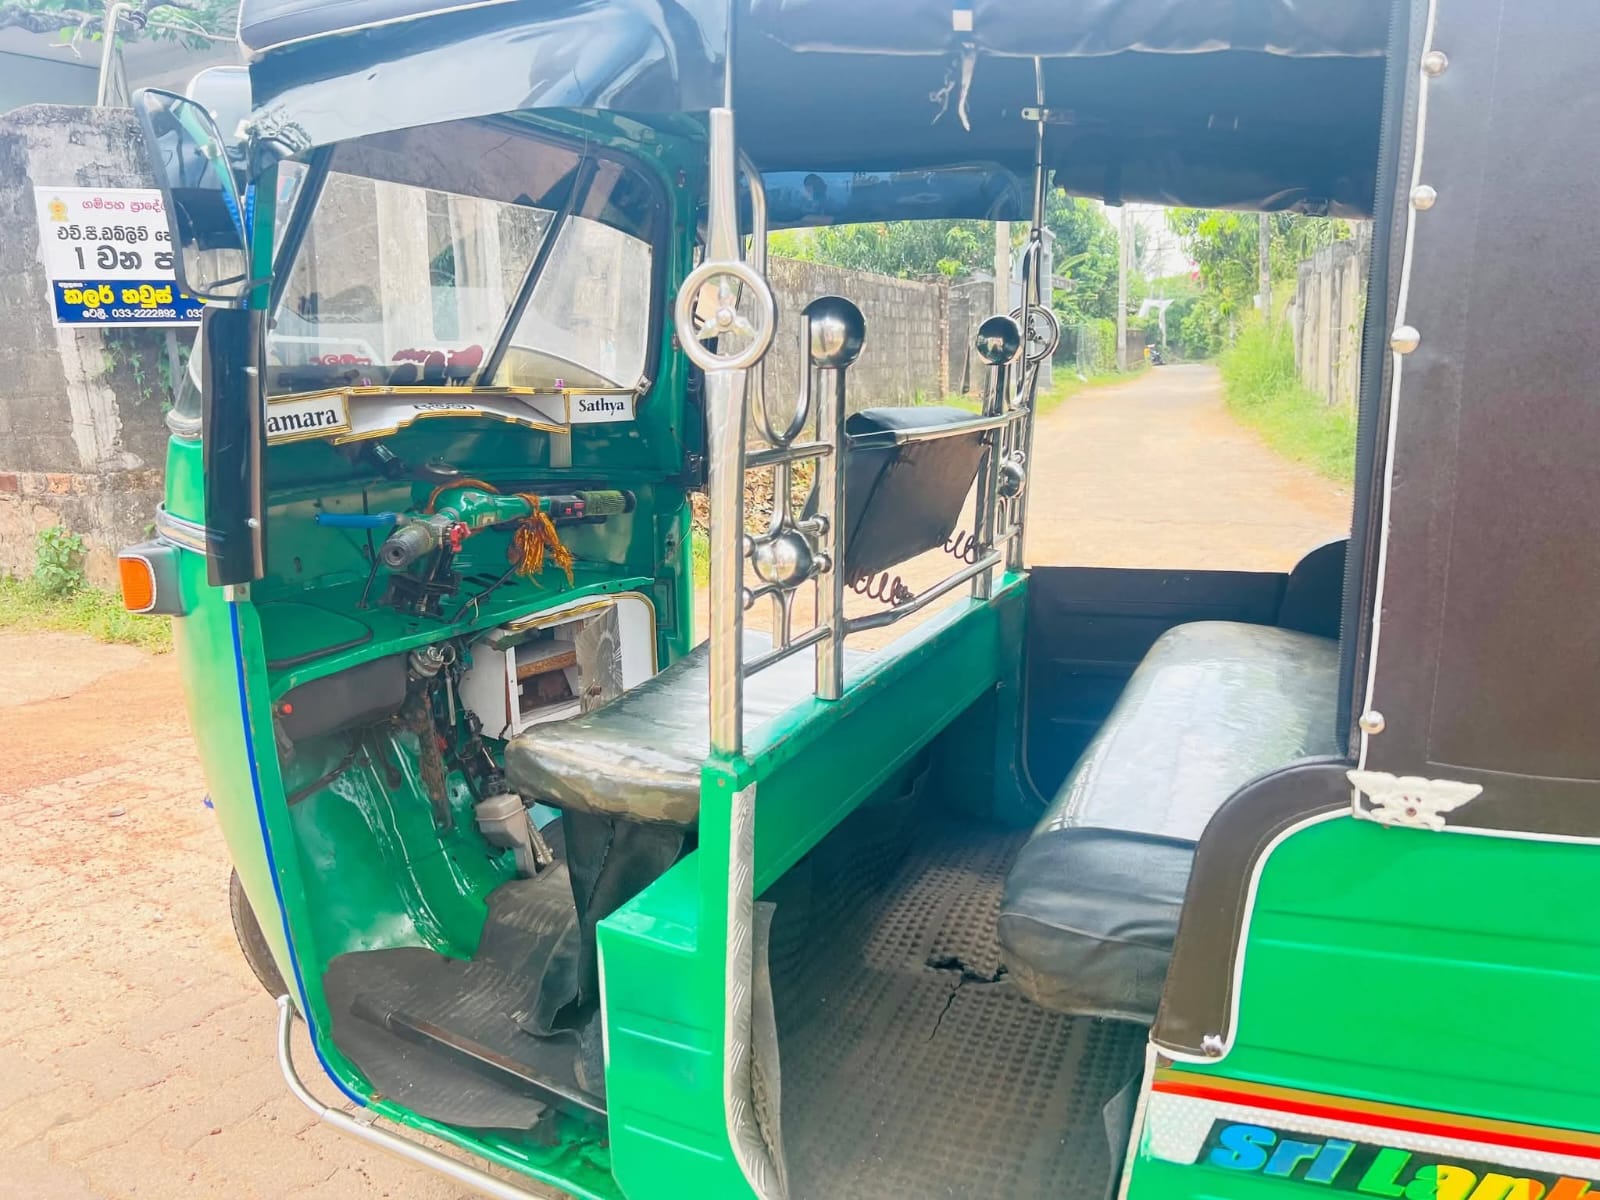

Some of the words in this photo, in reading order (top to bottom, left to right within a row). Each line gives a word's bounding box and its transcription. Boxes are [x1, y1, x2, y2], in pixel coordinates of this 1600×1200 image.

[82, 197, 125, 209] ගම්පහ
[97, 245, 142, 270] වන
[64, 284, 115, 308] කලර්
[578, 398, 625, 416] Sathya
[267, 409, 339, 433] amara
[1210, 1124, 1357, 1184] Sri
